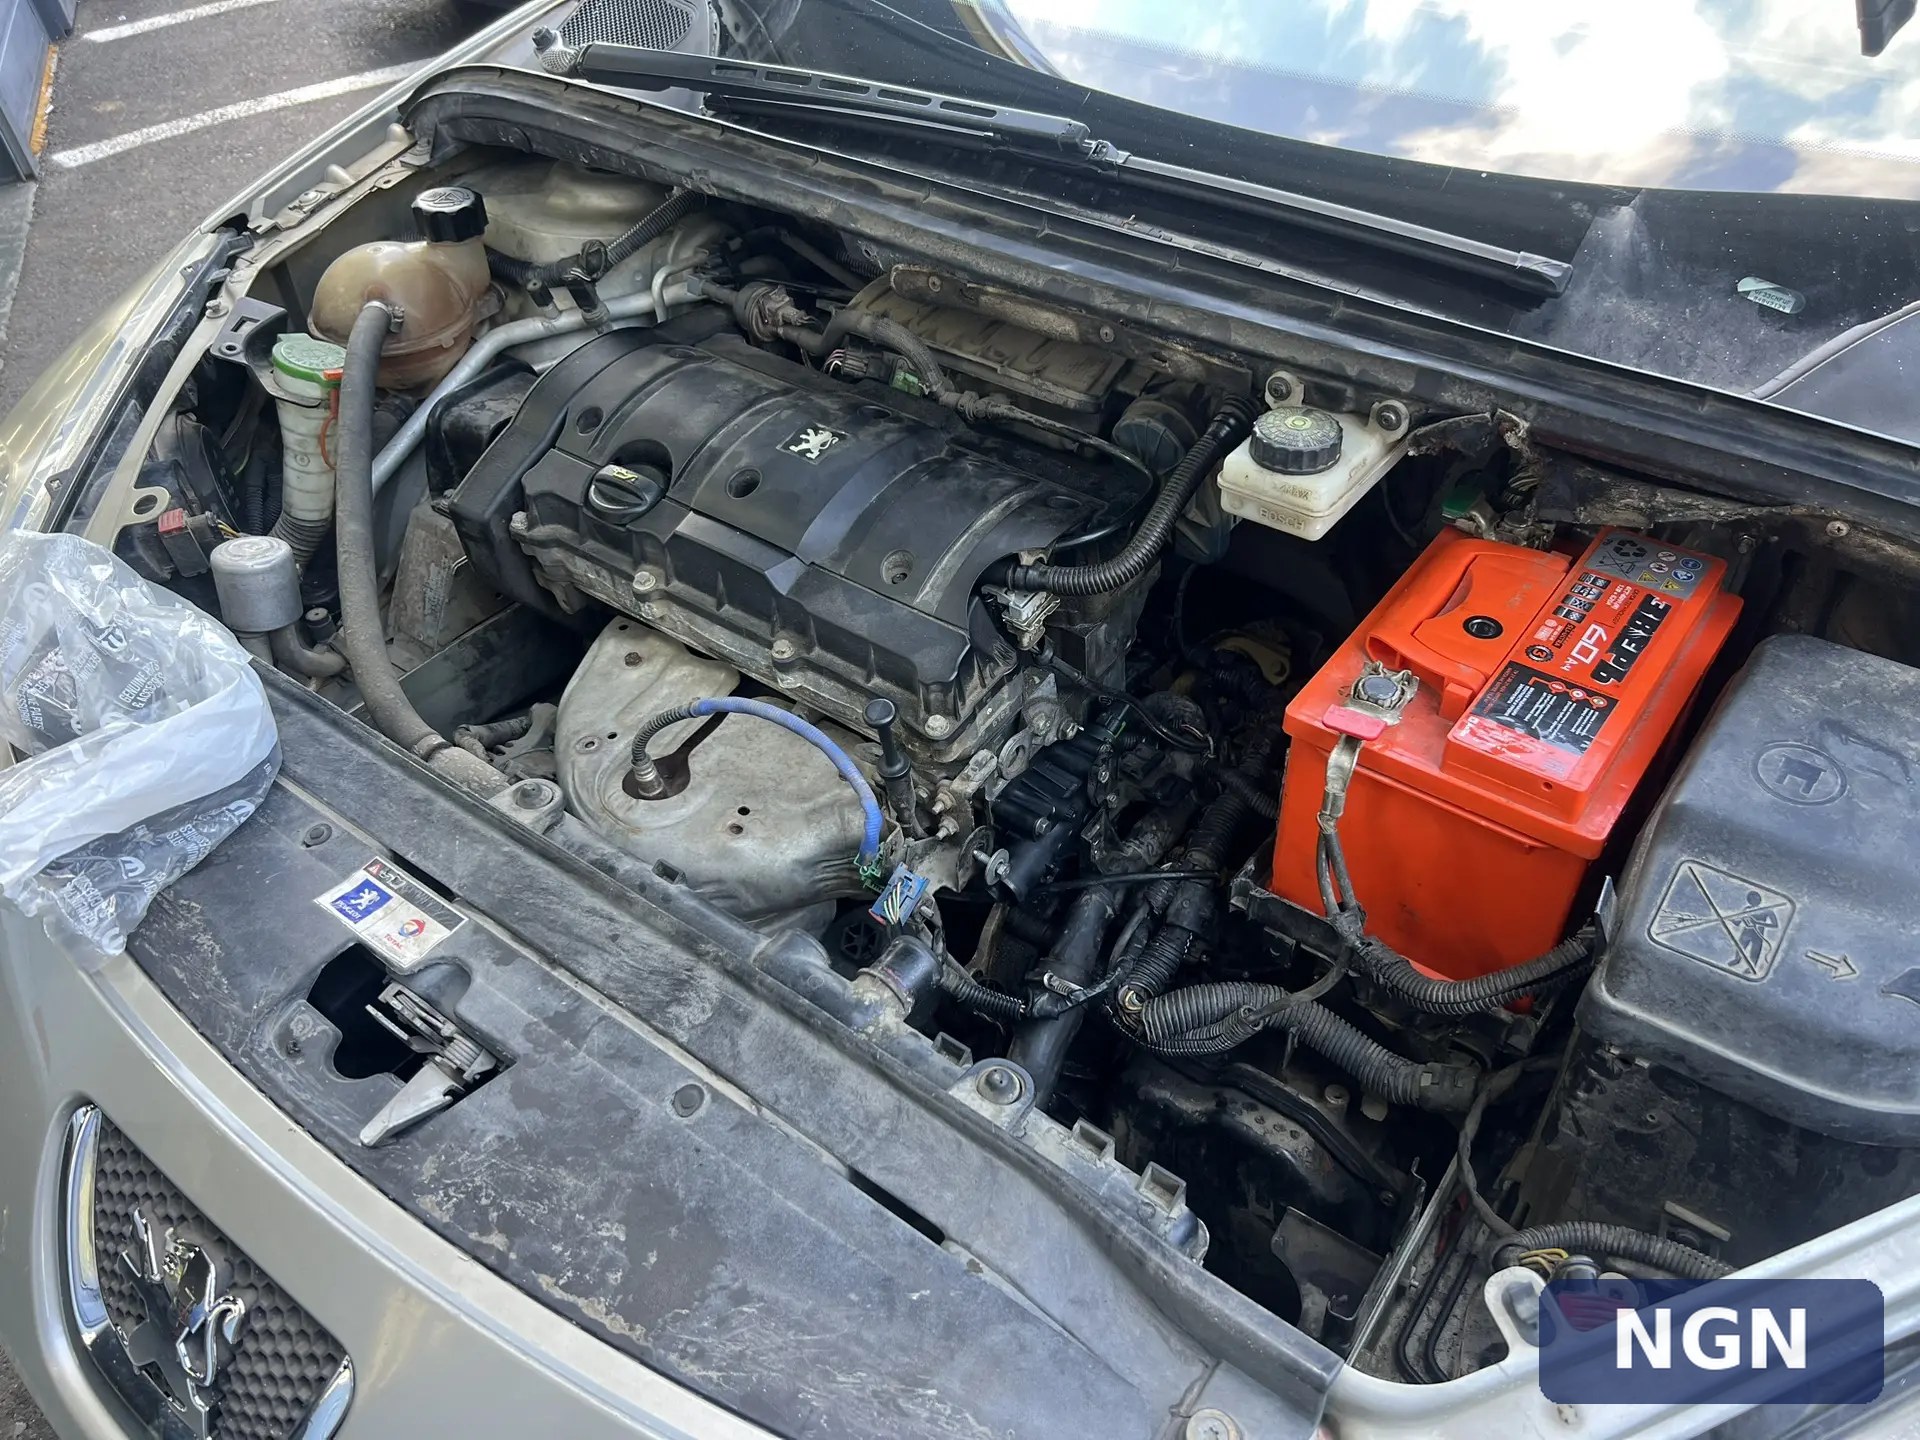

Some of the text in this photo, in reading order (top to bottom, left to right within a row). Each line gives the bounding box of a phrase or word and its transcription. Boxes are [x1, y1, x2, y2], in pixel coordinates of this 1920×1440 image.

[1259, 507, 1305, 532] BOSCH
[1532, 648, 1546, 659] 3
[1570, 623, 1608, 665] 60
[119, 670, 145, 704] GENUINE
[131, 698, 145, 709] &
[335, 900, 361, 920] PEUGEOT
[384, 933, 404, 950] TOTAL
